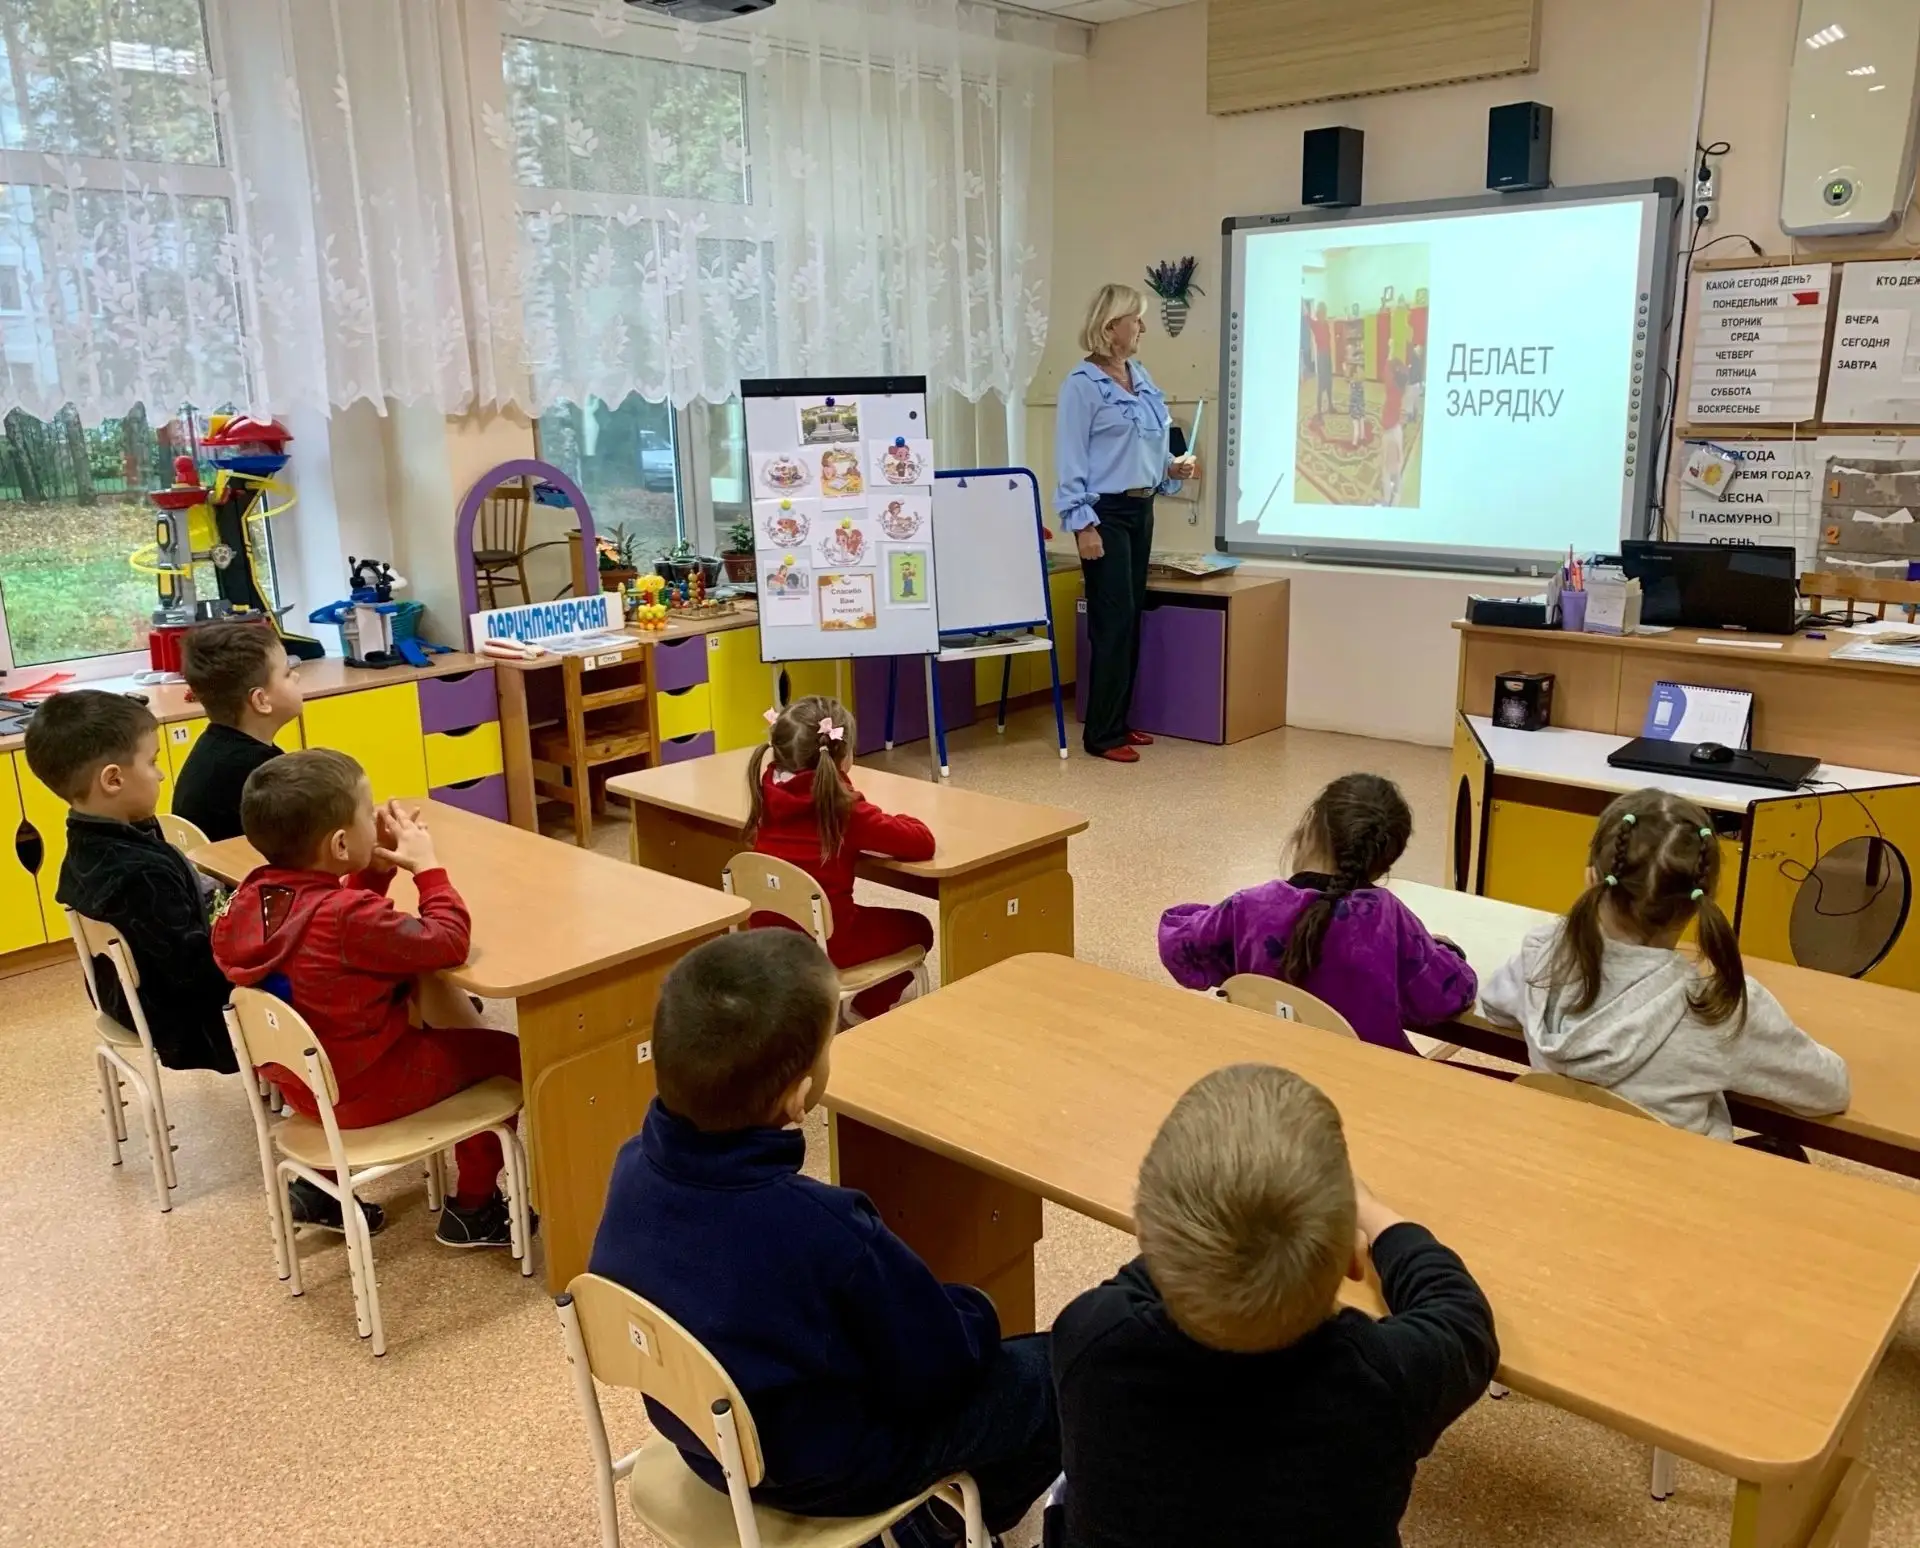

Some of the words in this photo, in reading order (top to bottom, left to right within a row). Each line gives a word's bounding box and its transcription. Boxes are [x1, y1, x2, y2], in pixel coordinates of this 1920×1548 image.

[1706, 277, 1735, 291] КАКОЙ
[1738, 276, 1779, 289] СЕГОДНЯ
[1780, 274, 1812, 286] ДЕНЬ?
[1876, 275, 1898, 286] КТО
[1712, 297, 1778, 309] ПОНЕДЕЛЬНИК
[1721, 317, 1763, 327] ВТОРНИК
[1845, 315, 1879, 325] ВЧЕРА
[1730, 332, 1760, 342] СРЕДА
[1841, 337, 1890, 348] СЕГОДНЯ
[1715, 350, 1754, 360] ЧЕТВЕРГ
[1447, 343, 1554, 382] ДЕЛАЕТ
[1837, 360, 1877, 370] ЗАВТРА
[1715, 368, 1757, 378] ПЯТНИЦА
[1710, 387, 1752, 397] СУББОТА
[1446, 388, 1564, 422] ЗАРЯДКУ
[1697, 404, 1761, 414] ВОСКРЕСЕНЬЕ
[1734, 470, 1768, 480] РЕМЯ
[1771, 470, 1811, 481] ГОДА?
[1699, 513, 1773, 524] ПАСМУРНО
[487, 597, 609, 641] ПАРИКМАХЕРСКАЯ
[711, 638, 719, 646] 12
[174, 729, 186, 739] 11
[770, 878, 776, 888] 1
[1011, 902, 1015, 912] 1
[1280, 1007, 1287, 1019] 1
[269, 1013, 276, 1026] 2
[641, 1047, 648, 1059] 2
[634, 1330, 642, 1345] 3
